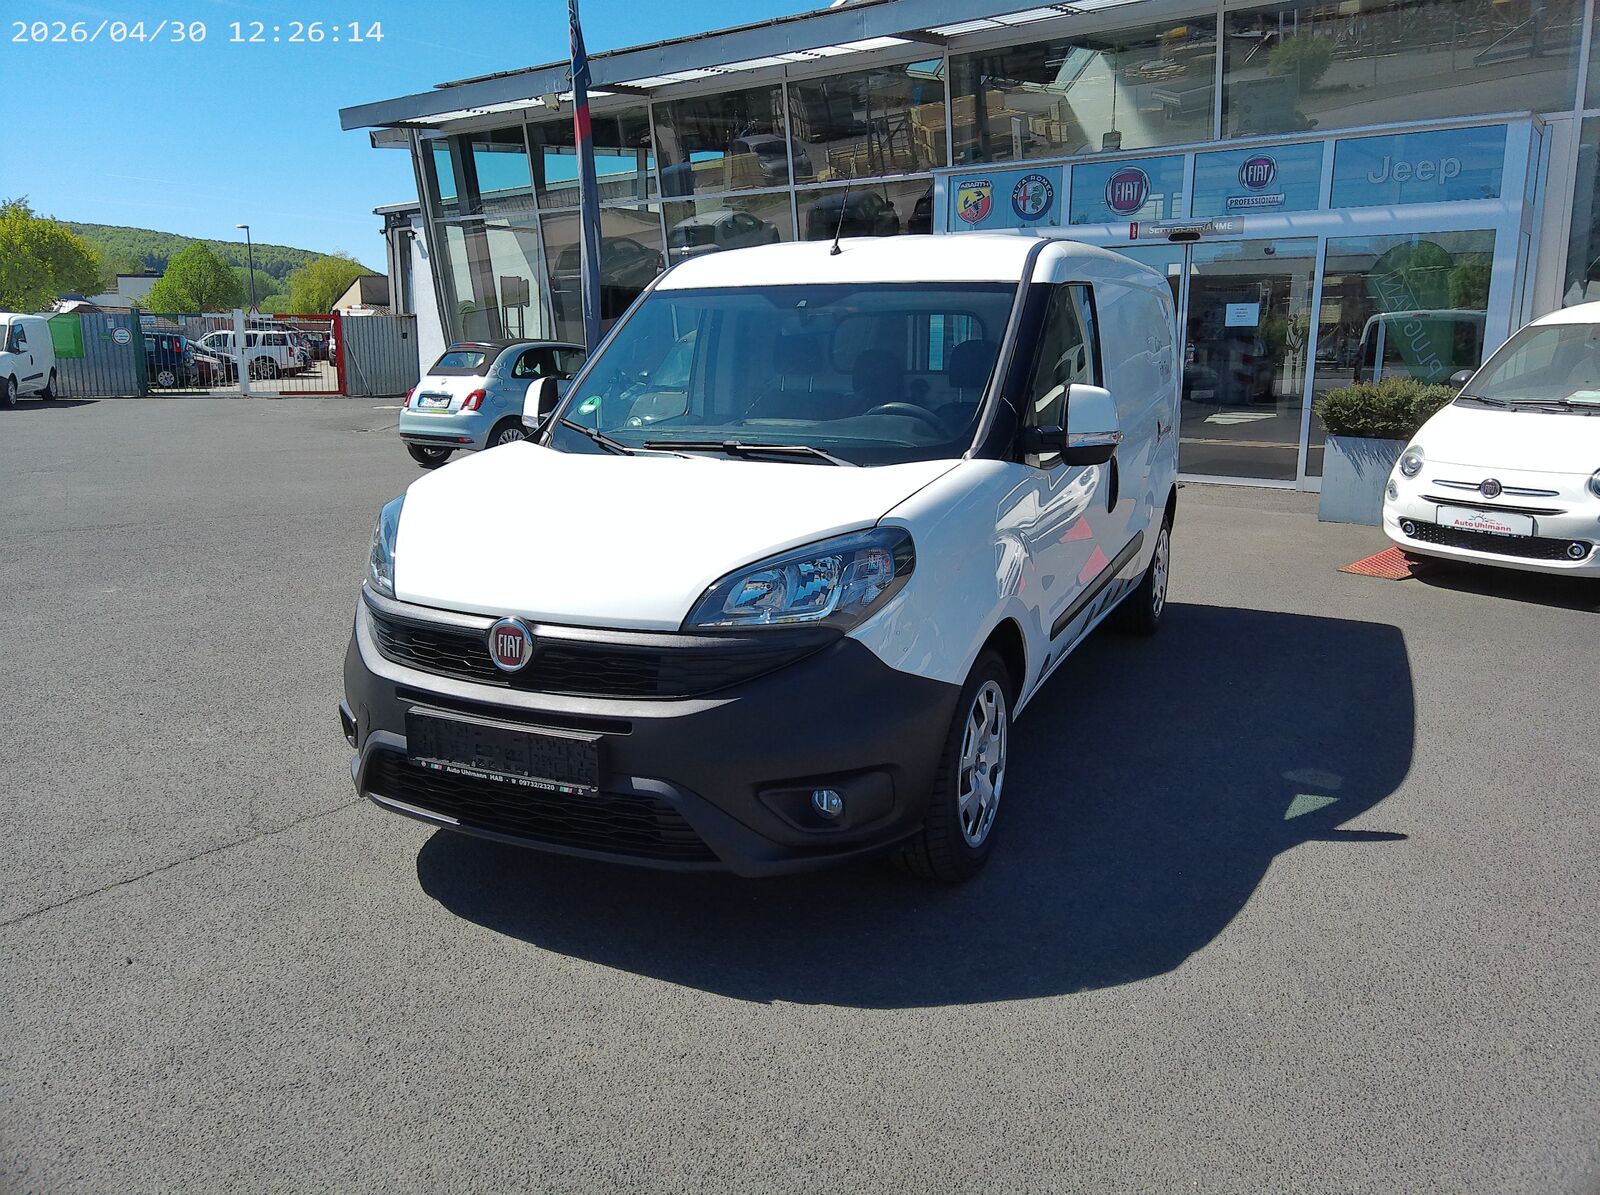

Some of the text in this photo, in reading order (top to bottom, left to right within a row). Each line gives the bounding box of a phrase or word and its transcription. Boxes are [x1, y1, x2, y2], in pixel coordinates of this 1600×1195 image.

[1247, 164, 1272, 182] FIAT
[1366, 154, 1462, 185] Jeep
[960, 181, 989, 190] ABARTH
[1013, 175, 1053, 200] ALFA ROMEO
[1115, 180, 1140, 202] FIAT
[1229, 196, 1281, 206] PROFESSIONAL
[1454, 519, 1474, 528] Auto
[1474, 521, 1511, 533] Uhlmann
[498, 633, 523, 658] FIAT
[446, 766, 461, 775] Auto
